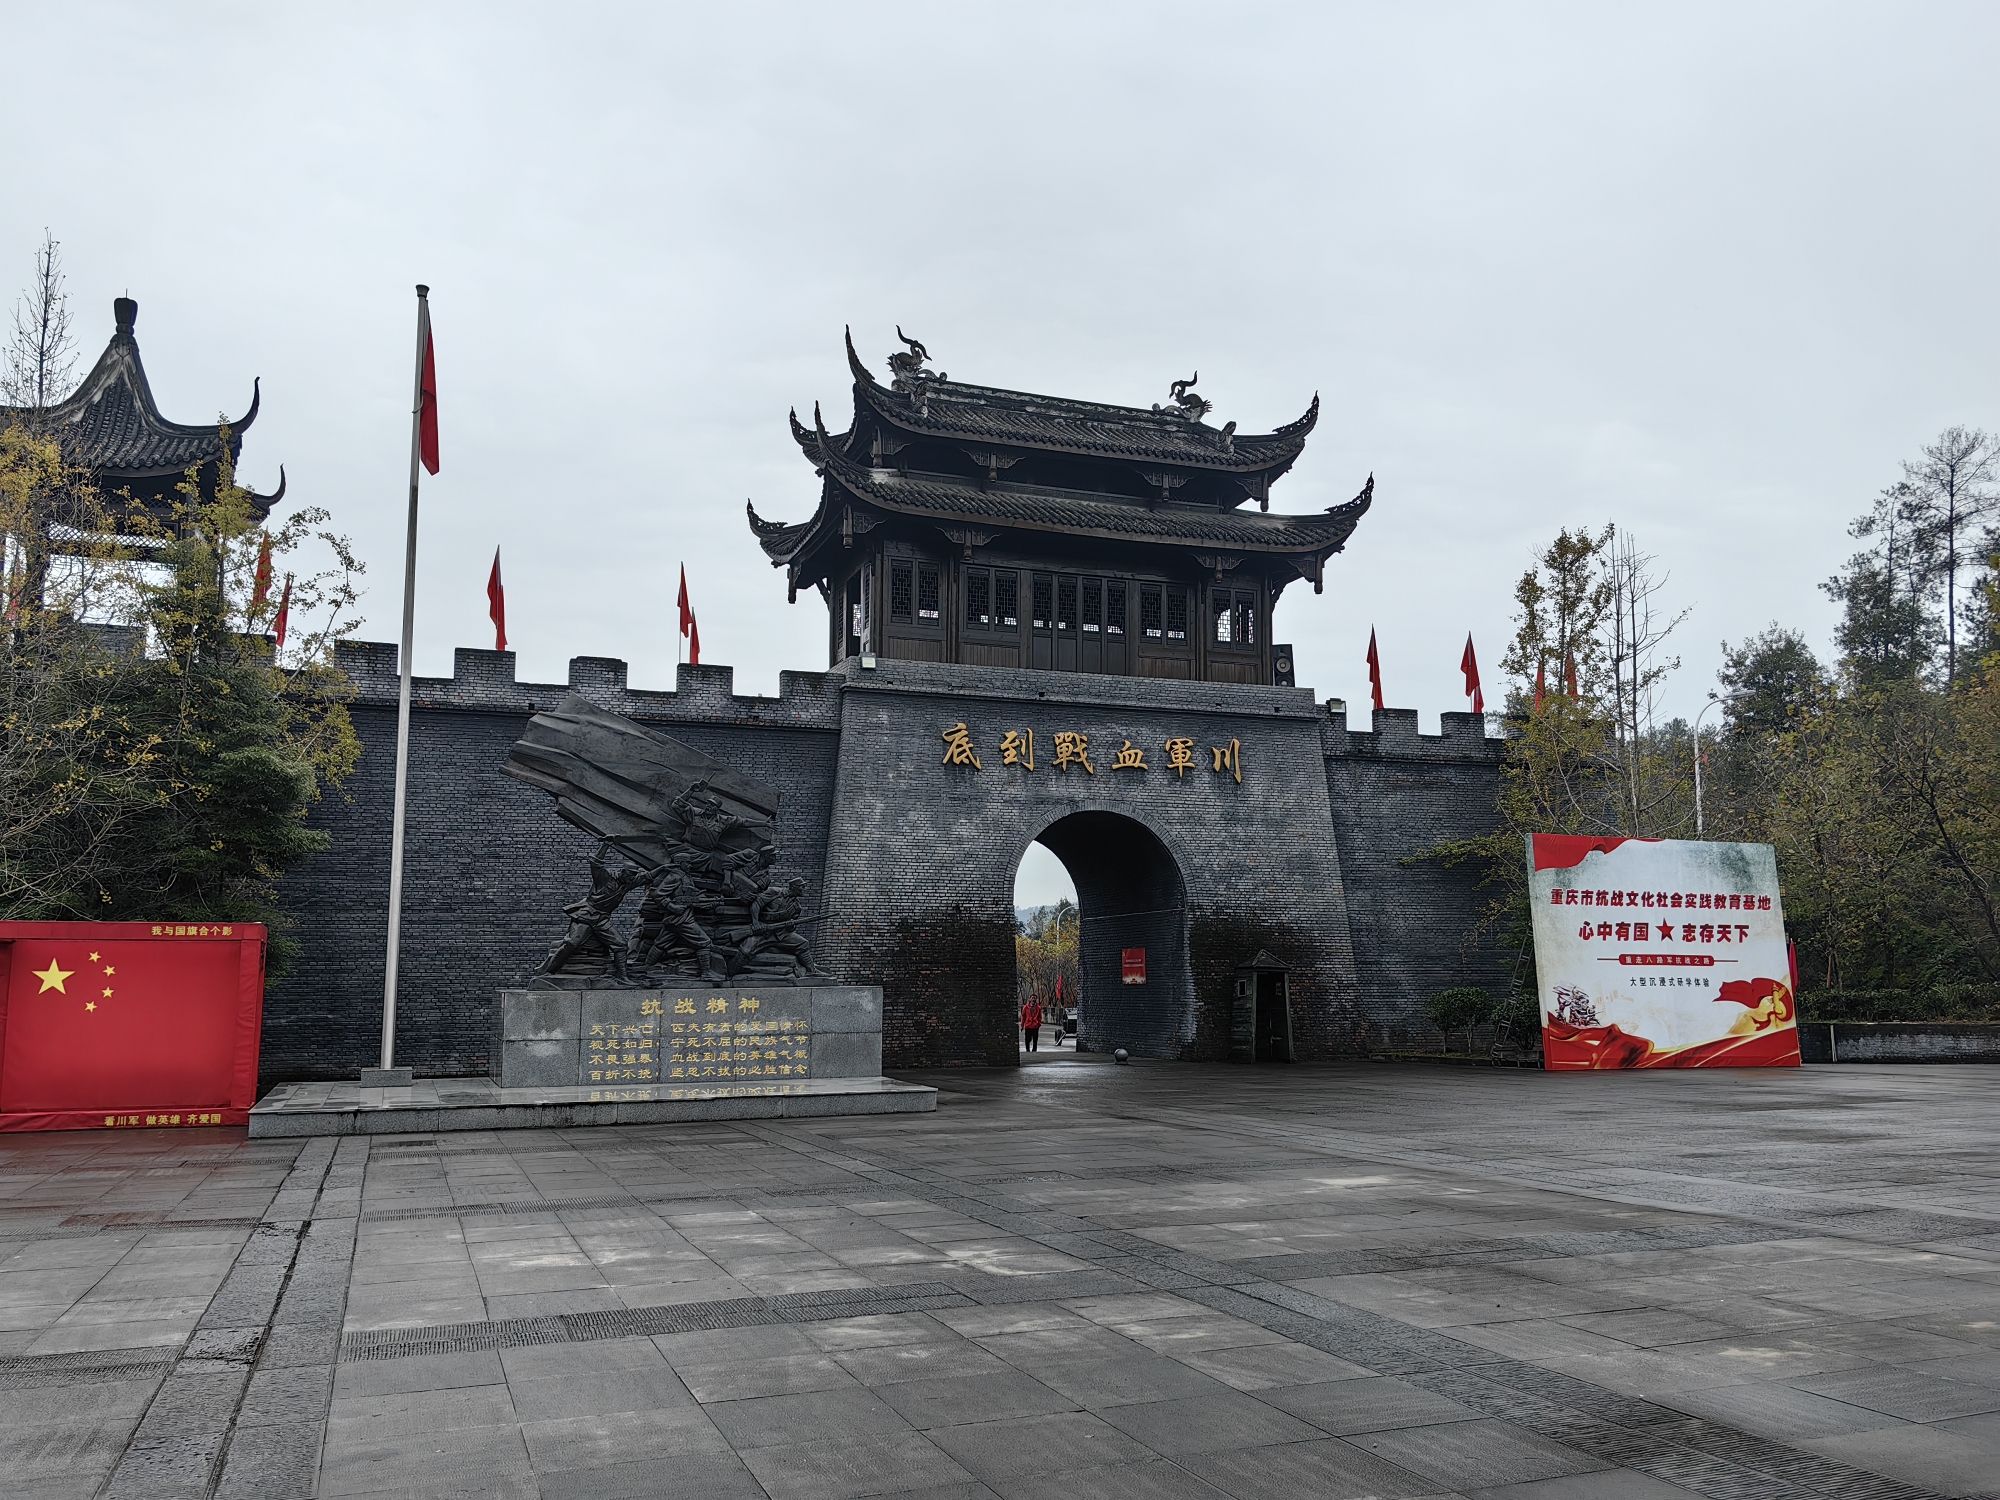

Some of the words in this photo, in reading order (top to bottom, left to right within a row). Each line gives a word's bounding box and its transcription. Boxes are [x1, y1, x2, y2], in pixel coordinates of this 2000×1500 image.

[1550, 888, 1771, 911] 重庆市抗战文化社会实践教育基地
[151, 925, 233, 936] 我与国旗合个影
[1579, 921, 1649, 942] 心中有国
[1682, 924, 1749, 943] 志存天下
[1625, 956, 1710, 965] 重走八路军抗战之路
[1630, 977, 1710, 987] 大型沉浸式研学体验
[640, 998, 760, 1016] 抗战精神
[104, 1115, 140, 1126] 看川军
[146, 1114, 181, 1125] 做英雄
[187, 1113, 221, 1124] 齐爱国
